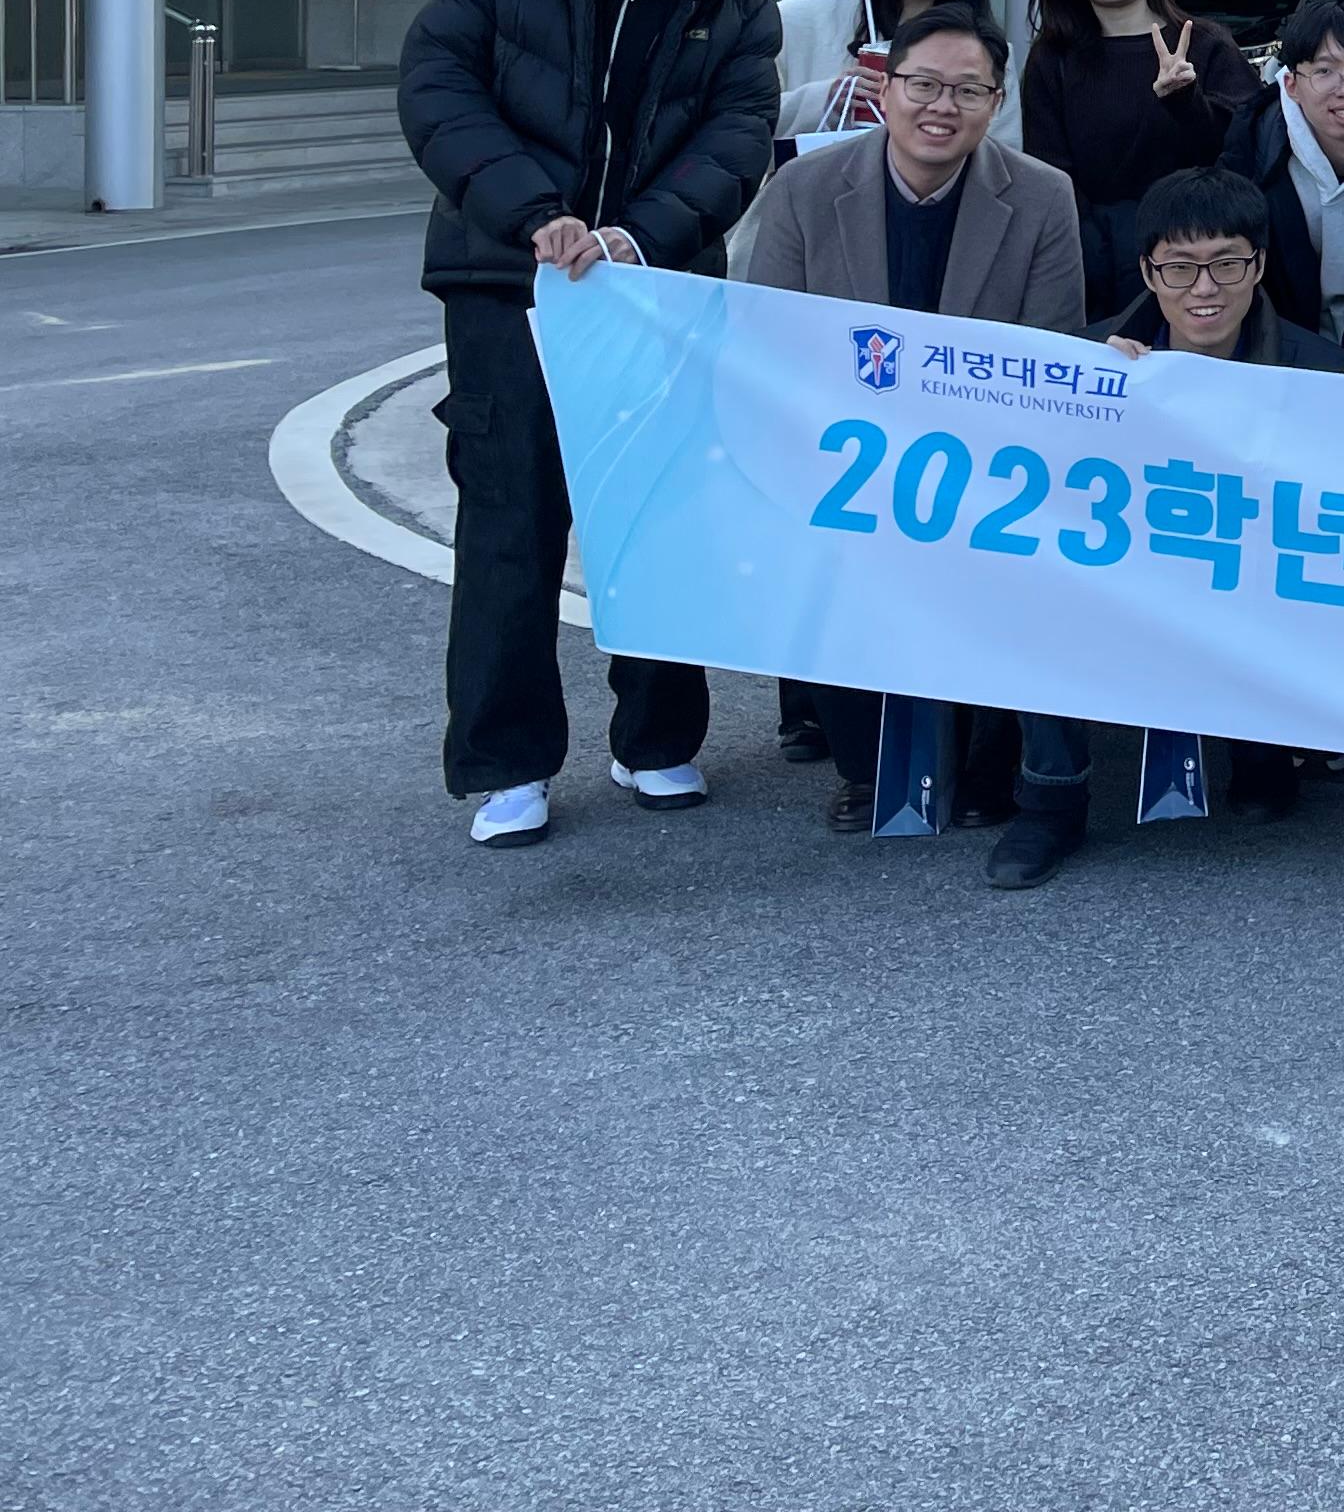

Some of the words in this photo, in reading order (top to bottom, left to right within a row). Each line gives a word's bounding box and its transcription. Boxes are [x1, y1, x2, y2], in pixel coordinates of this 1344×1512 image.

[921, 345, 1129, 398] 계명대학교
[921, 379, 1014, 407] KEIMYUNG
[1020, 395, 1125, 423] UNIVERSITY
